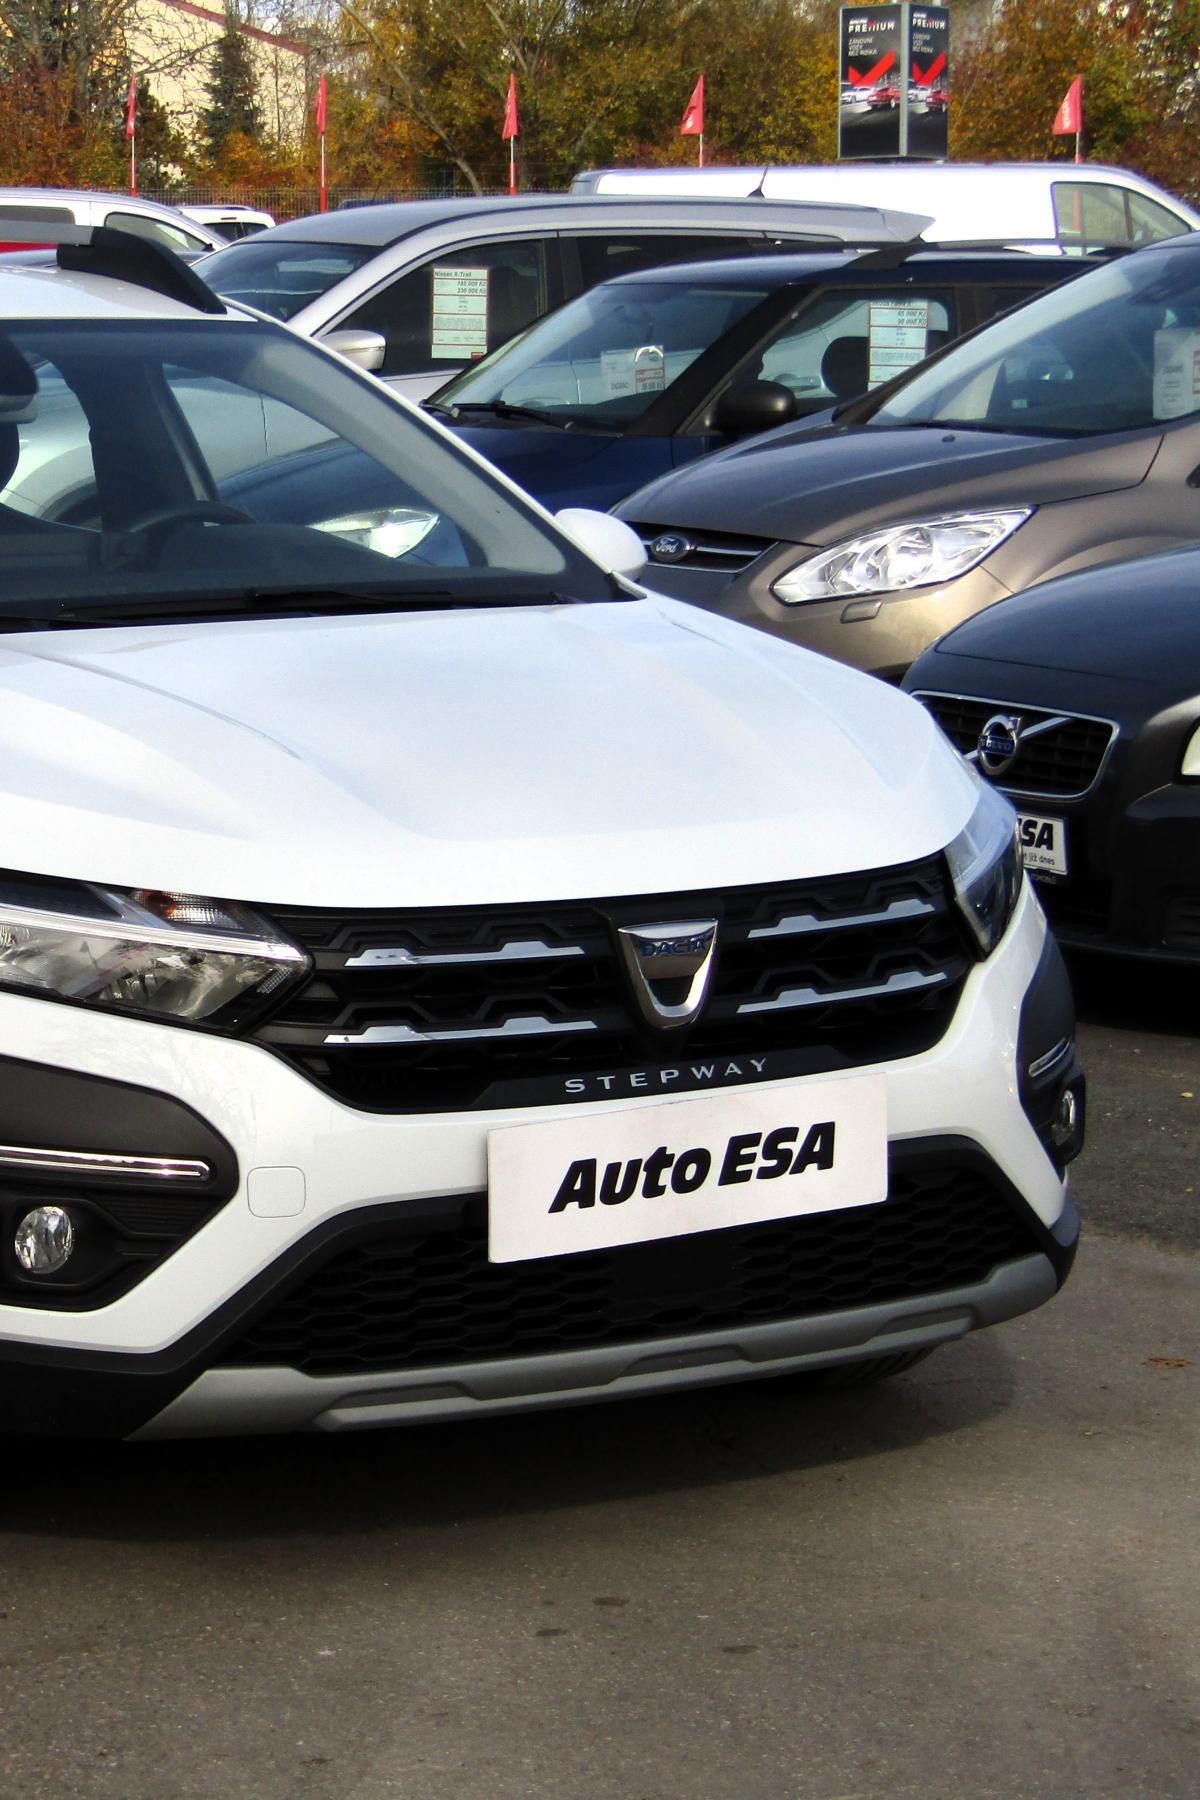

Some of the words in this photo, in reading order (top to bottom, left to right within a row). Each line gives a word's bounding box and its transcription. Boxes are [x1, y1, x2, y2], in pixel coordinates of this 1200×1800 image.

[655, 536, 679, 553] Ford
[641, 936, 706, 957] DACIA
[565, 1057, 767, 1093] STEPWAY
[548, 1146, 712, 1214] Auto
[717, 1121, 836, 1187] ESA
